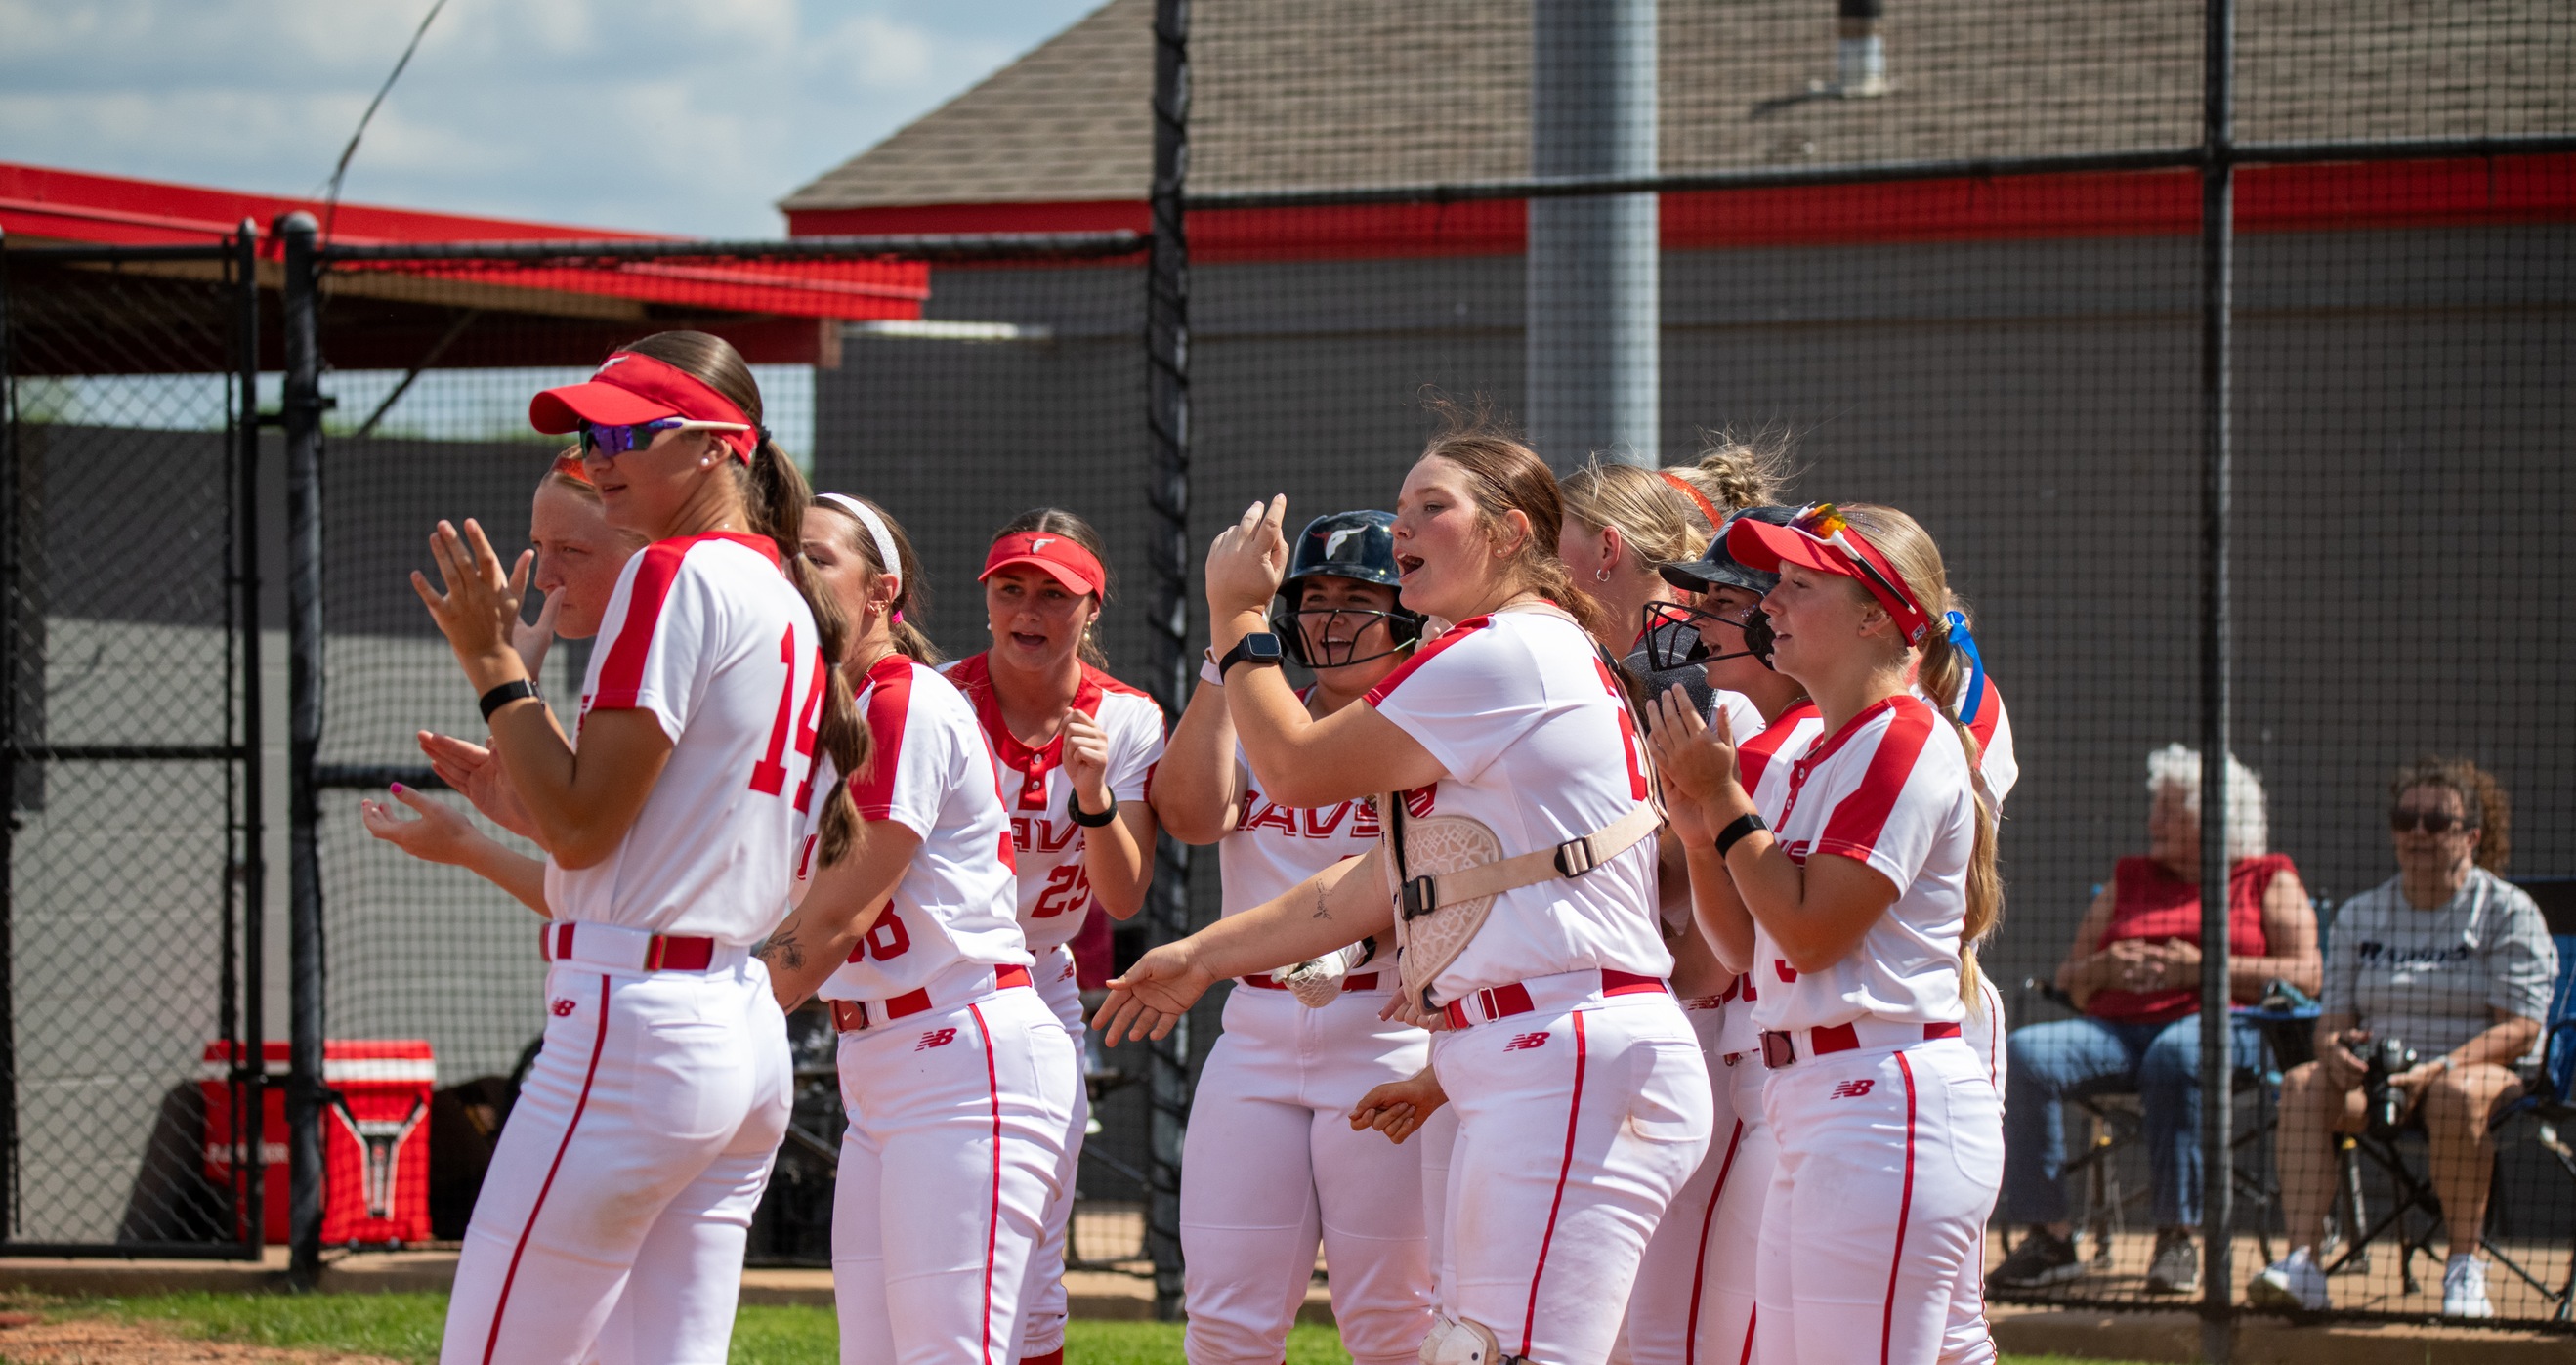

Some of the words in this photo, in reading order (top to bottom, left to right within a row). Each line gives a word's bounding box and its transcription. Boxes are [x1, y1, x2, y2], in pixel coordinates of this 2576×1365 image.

[914, 1027, 957, 1052] NB
[1502, 1031, 1551, 1052] NB
[1830, 1079, 1876, 1100] NB
